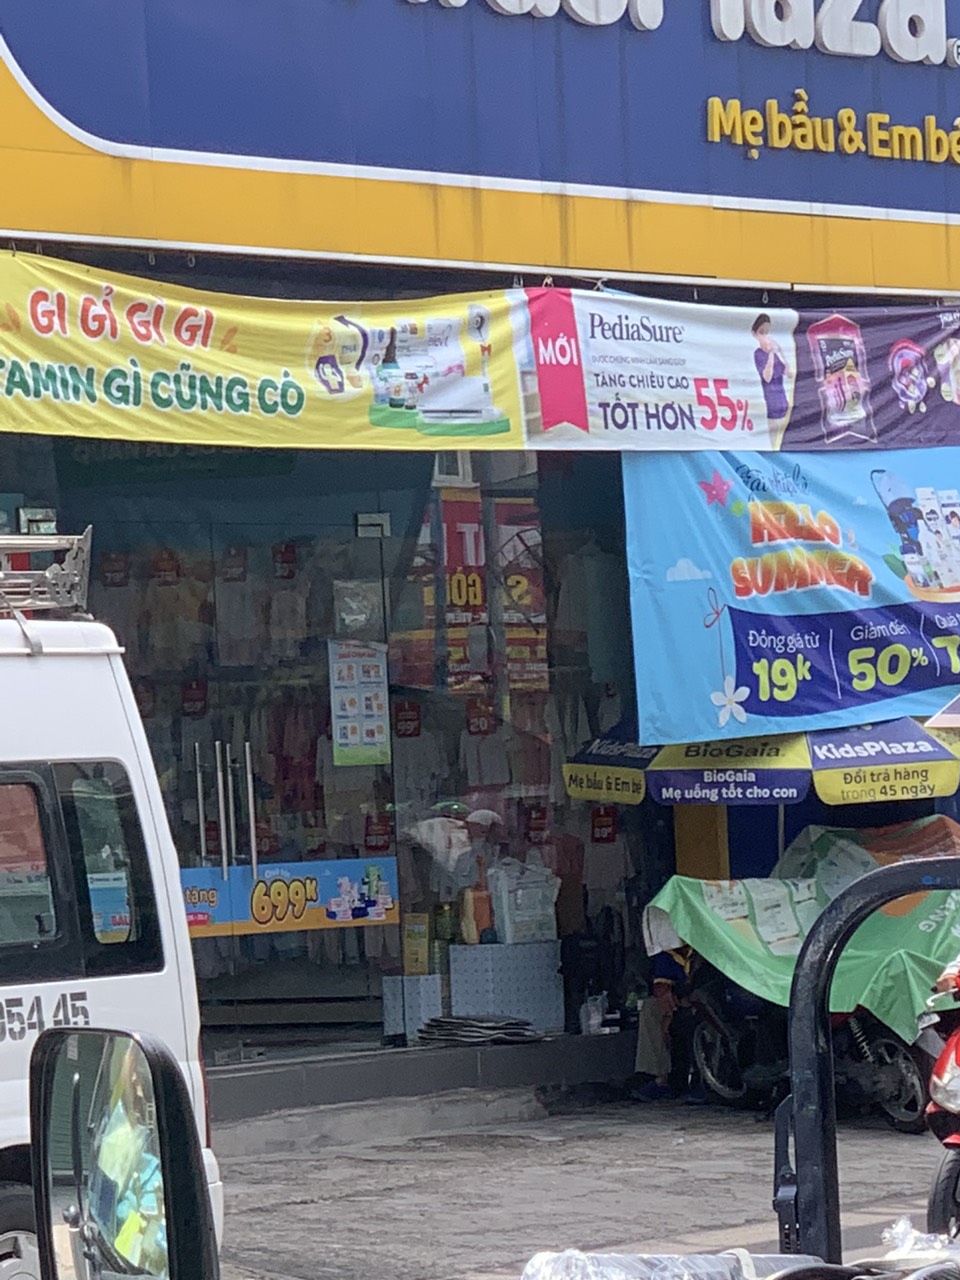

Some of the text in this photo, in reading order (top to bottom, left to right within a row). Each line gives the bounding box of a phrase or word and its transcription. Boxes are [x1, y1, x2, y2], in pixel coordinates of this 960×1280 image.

[707, 96, 763, 159] Mẹ
[766, 88, 835, 155] bầu
[838, 108, 866, 154] &
[867, 113, 924, 162] Em
[30, 290, 68, 335] GI
[174, 307, 215, 348] GI
[588, 312, 684, 343] PediaSure
[537, 329, 580, 367] MỚI
[0, 358, 97, 403] AMIN
[103, 358, 142, 407] GÌ
[150, 362, 250, 413] CŨNG
[667, 376, 689, 389] CAO
[598, 392, 697, 430] TỐT HƠN
[693, 377, 754, 431] 55%
[730, 546, 875, 600] SUMMER
[748, 628, 785, 652] Đồng
[850, 620, 889, 642] Giảm
[752, 653, 812, 702] 19k
[848, 643, 929, 691] 50%
[684, 742, 781, 759] BioGaia
[813, 740, 933, 761] KidsPlaza
[568, 773, 584, 789] Mẹ
[615, 777, 629, 792] Em
[703, 770, 756, 783] BioGaia
[843, 769, 867, 785] Đổi
[893, 769, 929, 783] hàng
[661, 786, 682, 802] Mẹ
[721, 785, 743, 799] tốt
[746, 786, 770, 798] cho
[772, 786, 797, 798] con
[879, 784, 897, 797] 45
[900, 781, 935, 799] ngày
[184, 887, 217, 907] tặng
